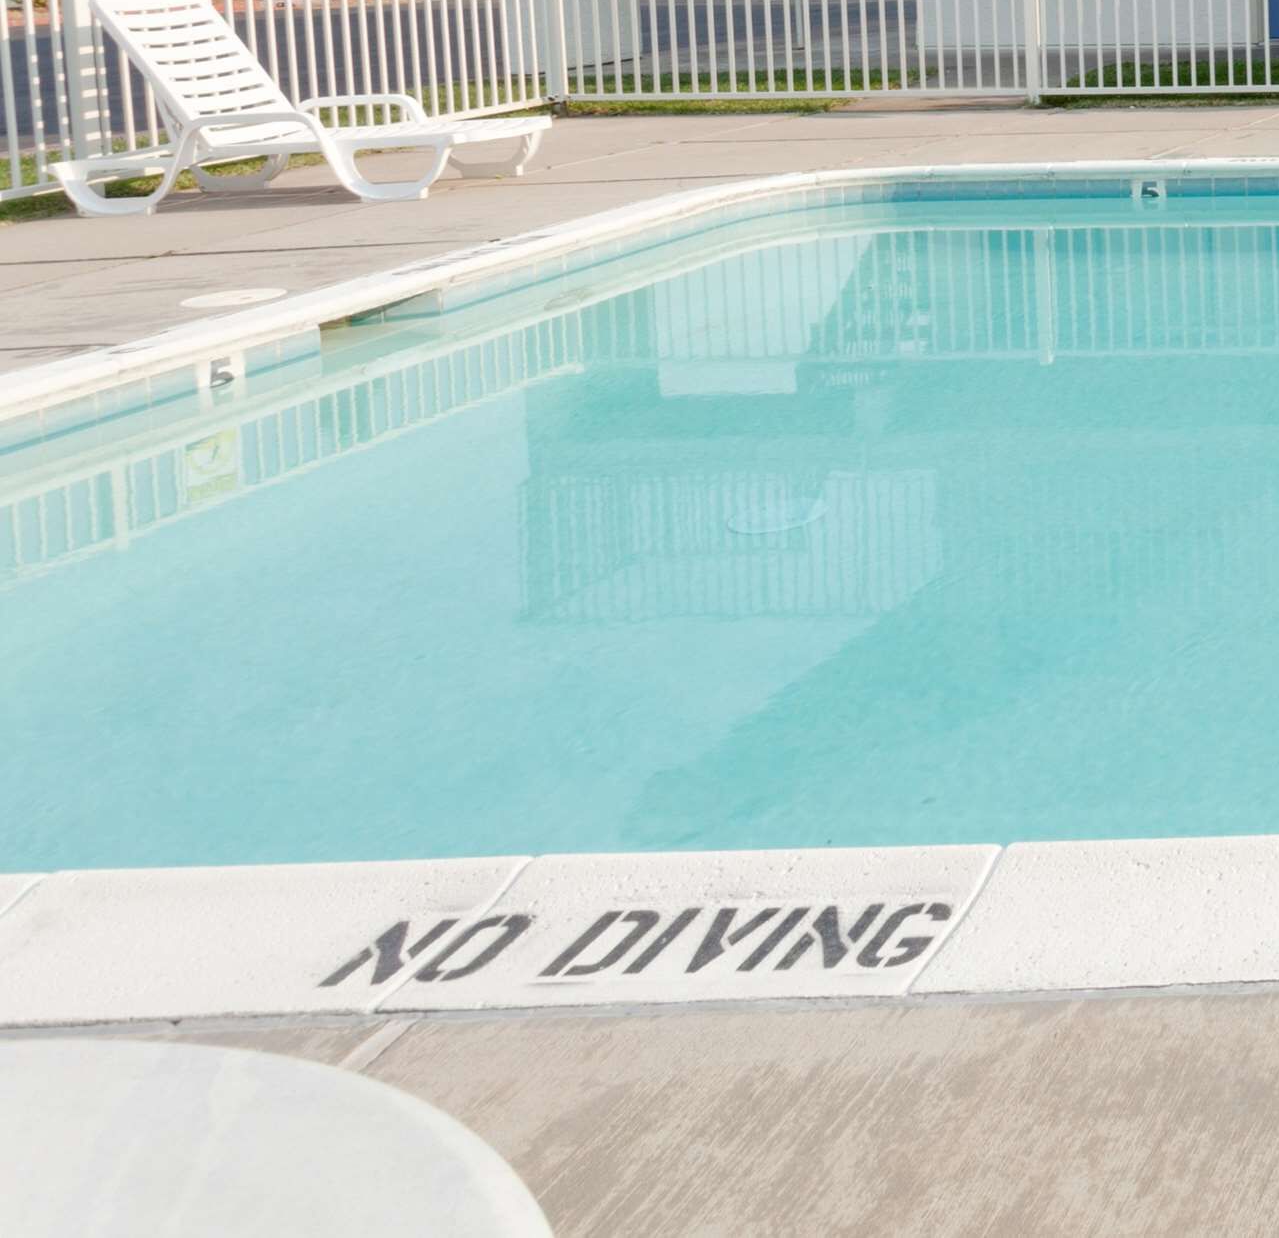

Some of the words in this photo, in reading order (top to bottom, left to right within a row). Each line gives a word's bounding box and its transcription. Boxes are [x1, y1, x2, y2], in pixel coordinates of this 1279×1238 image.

[1141, 181, 1160, 198] 5
[209, 356, 235, 389] 5
[316, 913, 536, 987] NO
[537, 902, 954, 977] DIVING
